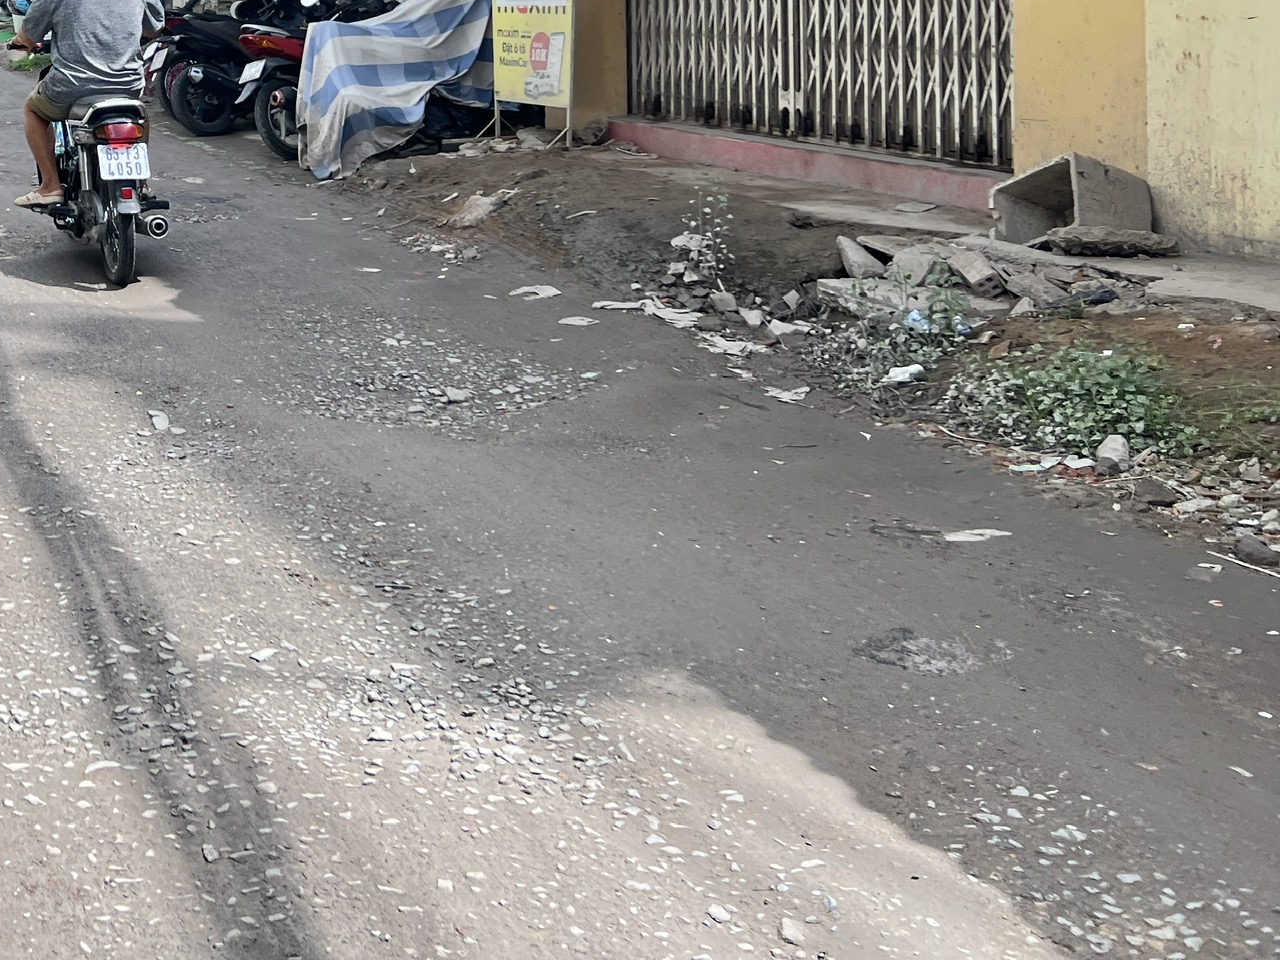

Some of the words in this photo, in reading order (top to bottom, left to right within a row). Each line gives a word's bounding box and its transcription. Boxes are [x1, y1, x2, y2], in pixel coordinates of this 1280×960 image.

[502, 42, 513, 55] Đặt
[531, 48, 548, 62] 10K
[106, 145, 140, 161] 65-F3
